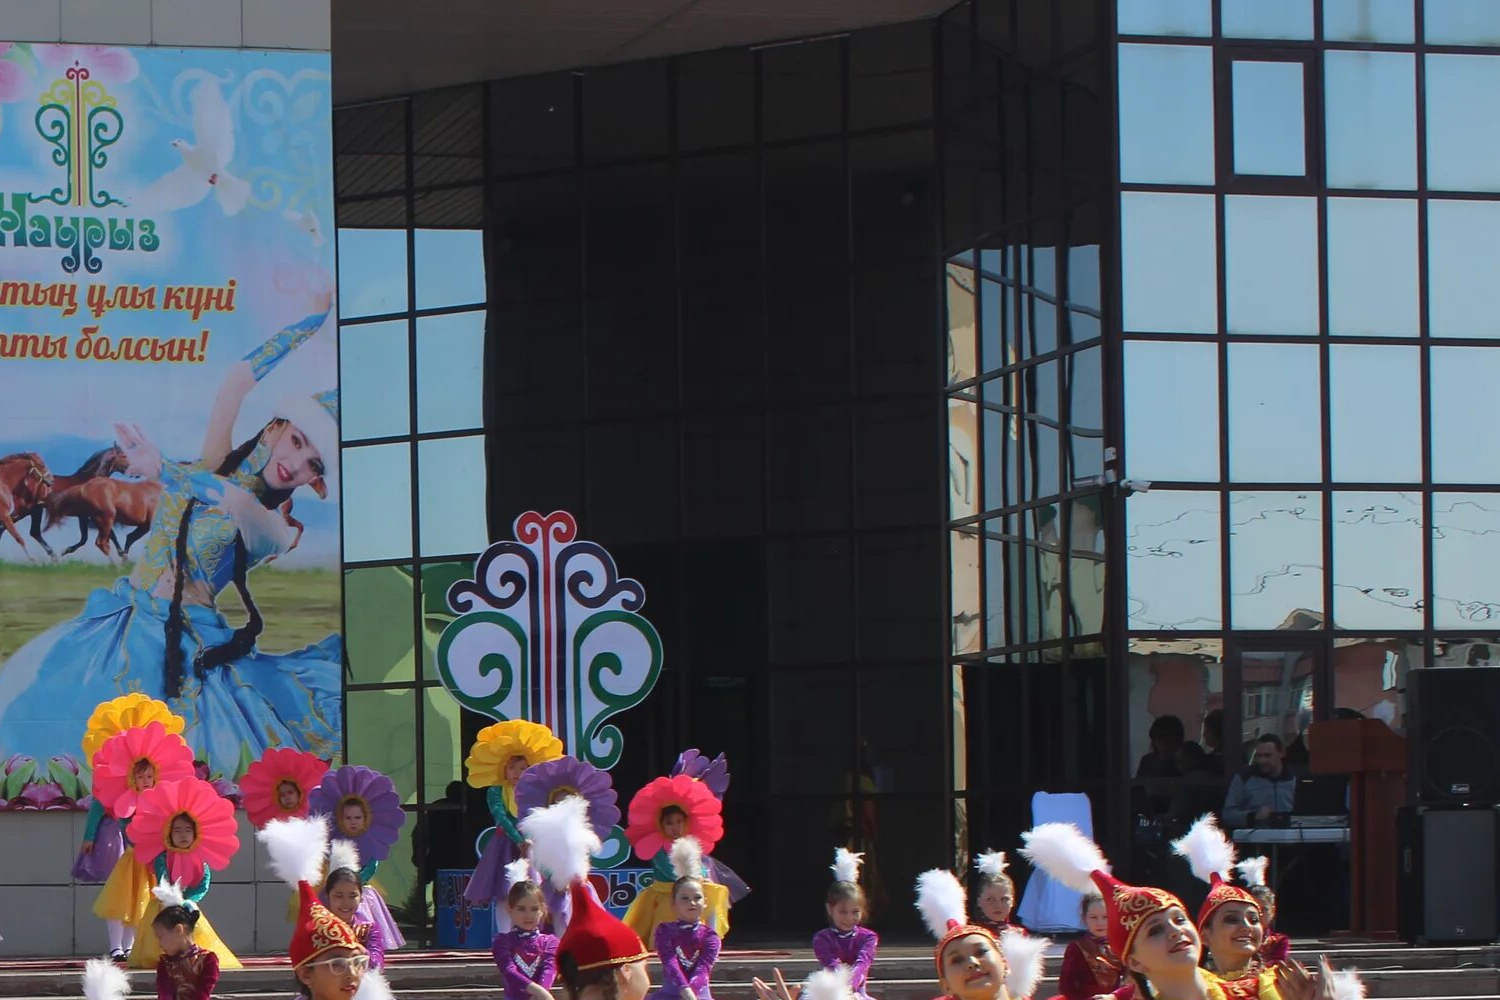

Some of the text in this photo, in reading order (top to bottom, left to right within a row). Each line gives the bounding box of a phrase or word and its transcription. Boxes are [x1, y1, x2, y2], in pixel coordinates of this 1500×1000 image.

[86, 282, 157, 318] ұлы
[163, 279, 238, 321] күні
[75, 326, 211, 363] болсын!
